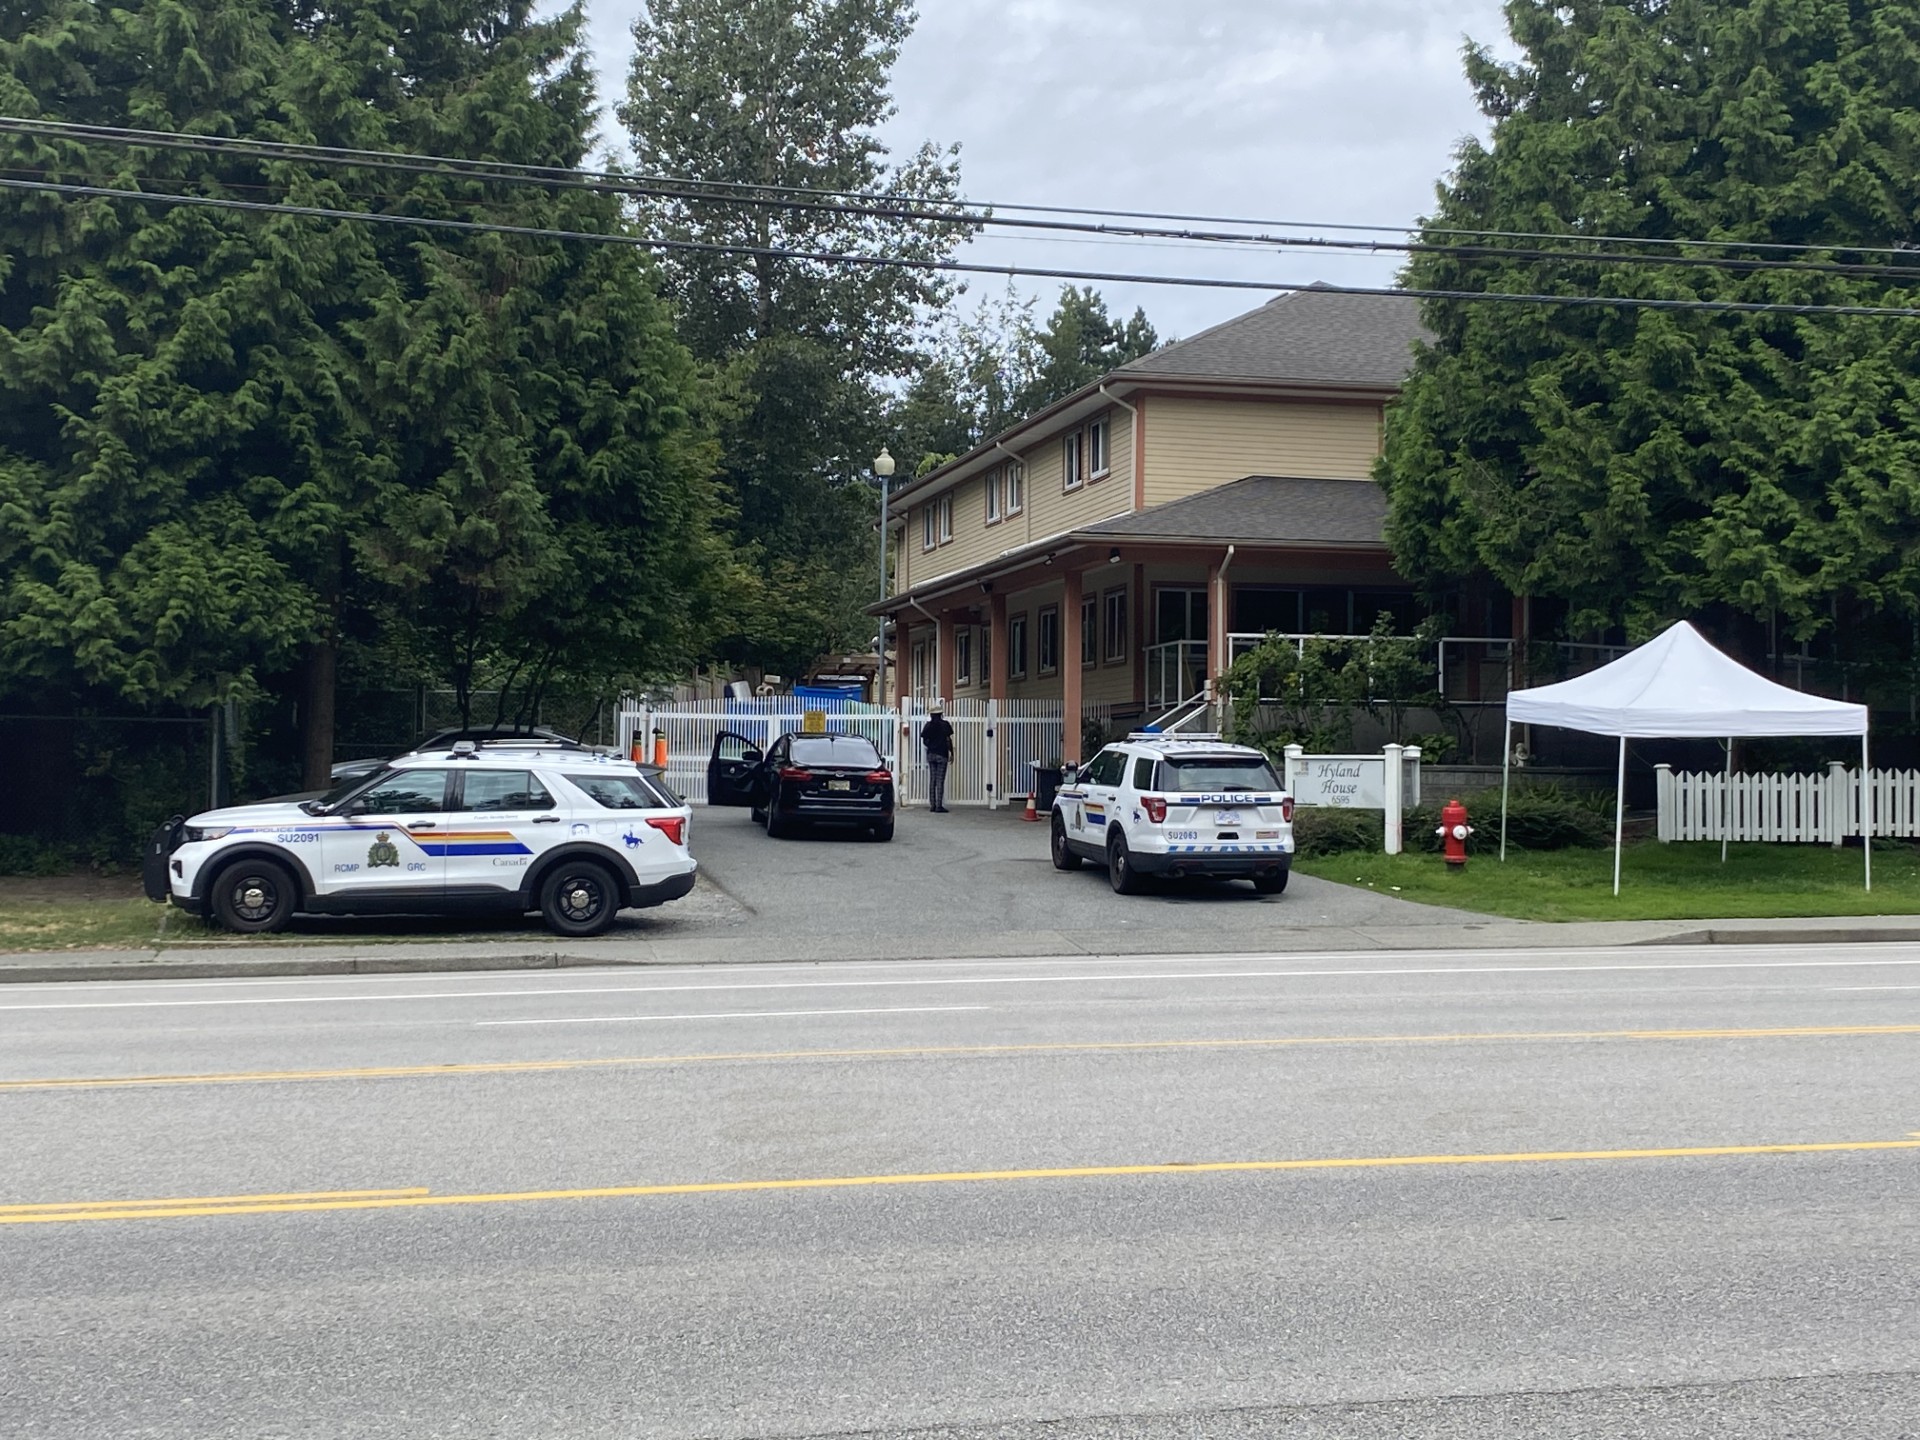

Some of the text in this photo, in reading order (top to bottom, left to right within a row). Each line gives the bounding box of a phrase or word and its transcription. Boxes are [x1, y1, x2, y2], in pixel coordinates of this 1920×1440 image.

[1318, 762, 1363, 780] Hyland
[1321, 780, 1357, 794] House
[1201, 794, 1254, 803] POLICE
[1331, 795, 1350, 805] 6595
[277, 833, 320, 843] SU2091
[492, 857, 528, 867] Canada
[334, 862, 427, 873] RCMP GRC
